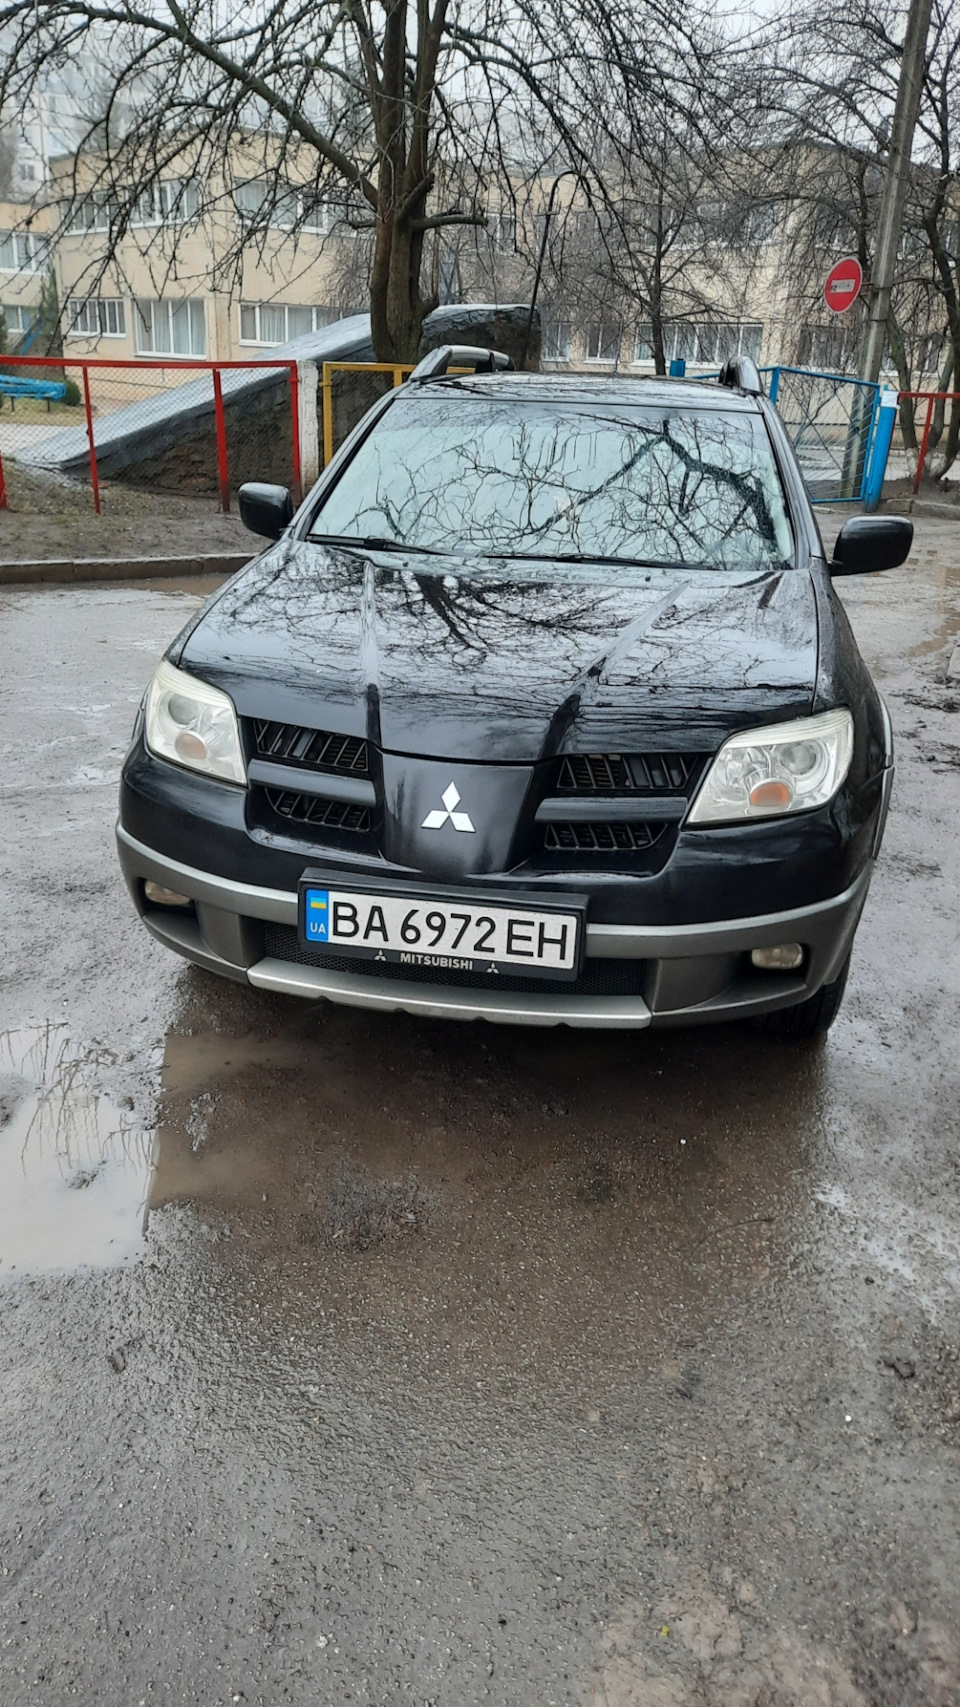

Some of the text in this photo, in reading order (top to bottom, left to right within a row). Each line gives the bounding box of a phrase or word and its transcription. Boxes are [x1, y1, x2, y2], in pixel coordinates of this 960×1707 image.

[310, 921, 327, 935] UA
[333, 901, 568, 960] BA 6972 EH
[400, 952, 473, 970] MITSUBISHI
